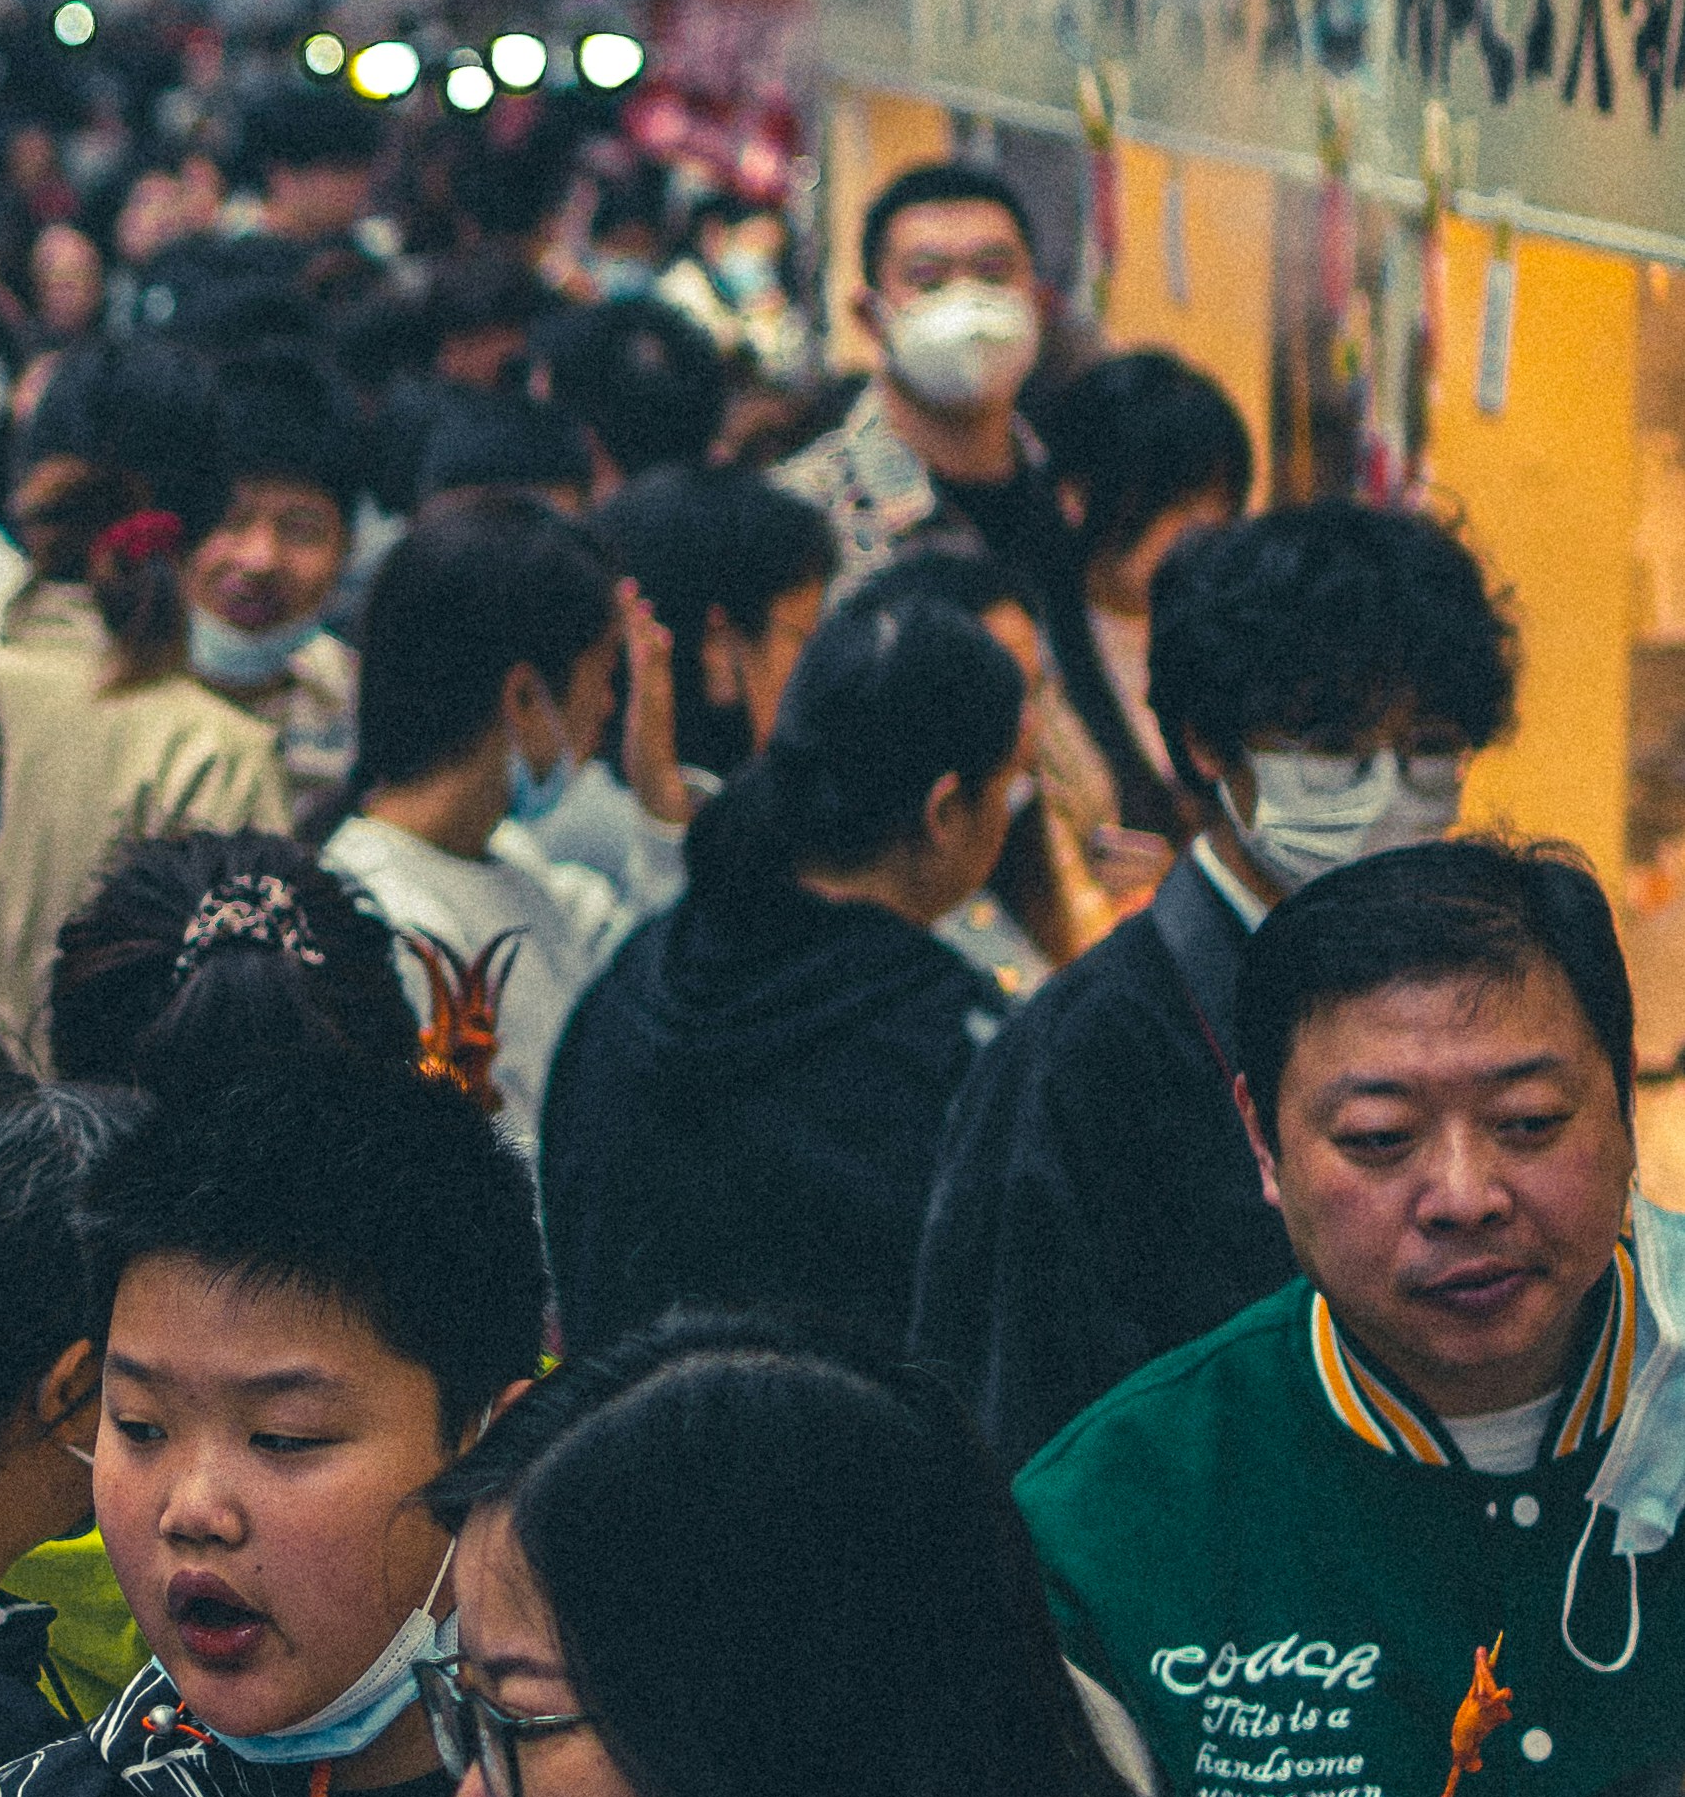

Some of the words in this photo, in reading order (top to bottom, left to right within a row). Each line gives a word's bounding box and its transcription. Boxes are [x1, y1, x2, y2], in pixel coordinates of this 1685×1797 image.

[1202, 1695, 1283, 1738] This
[1290, 1699, 1322, 1732] is
[1327, 1707, 1351, 1729] a
[1195, 1742, 1364, 1783] handsome
